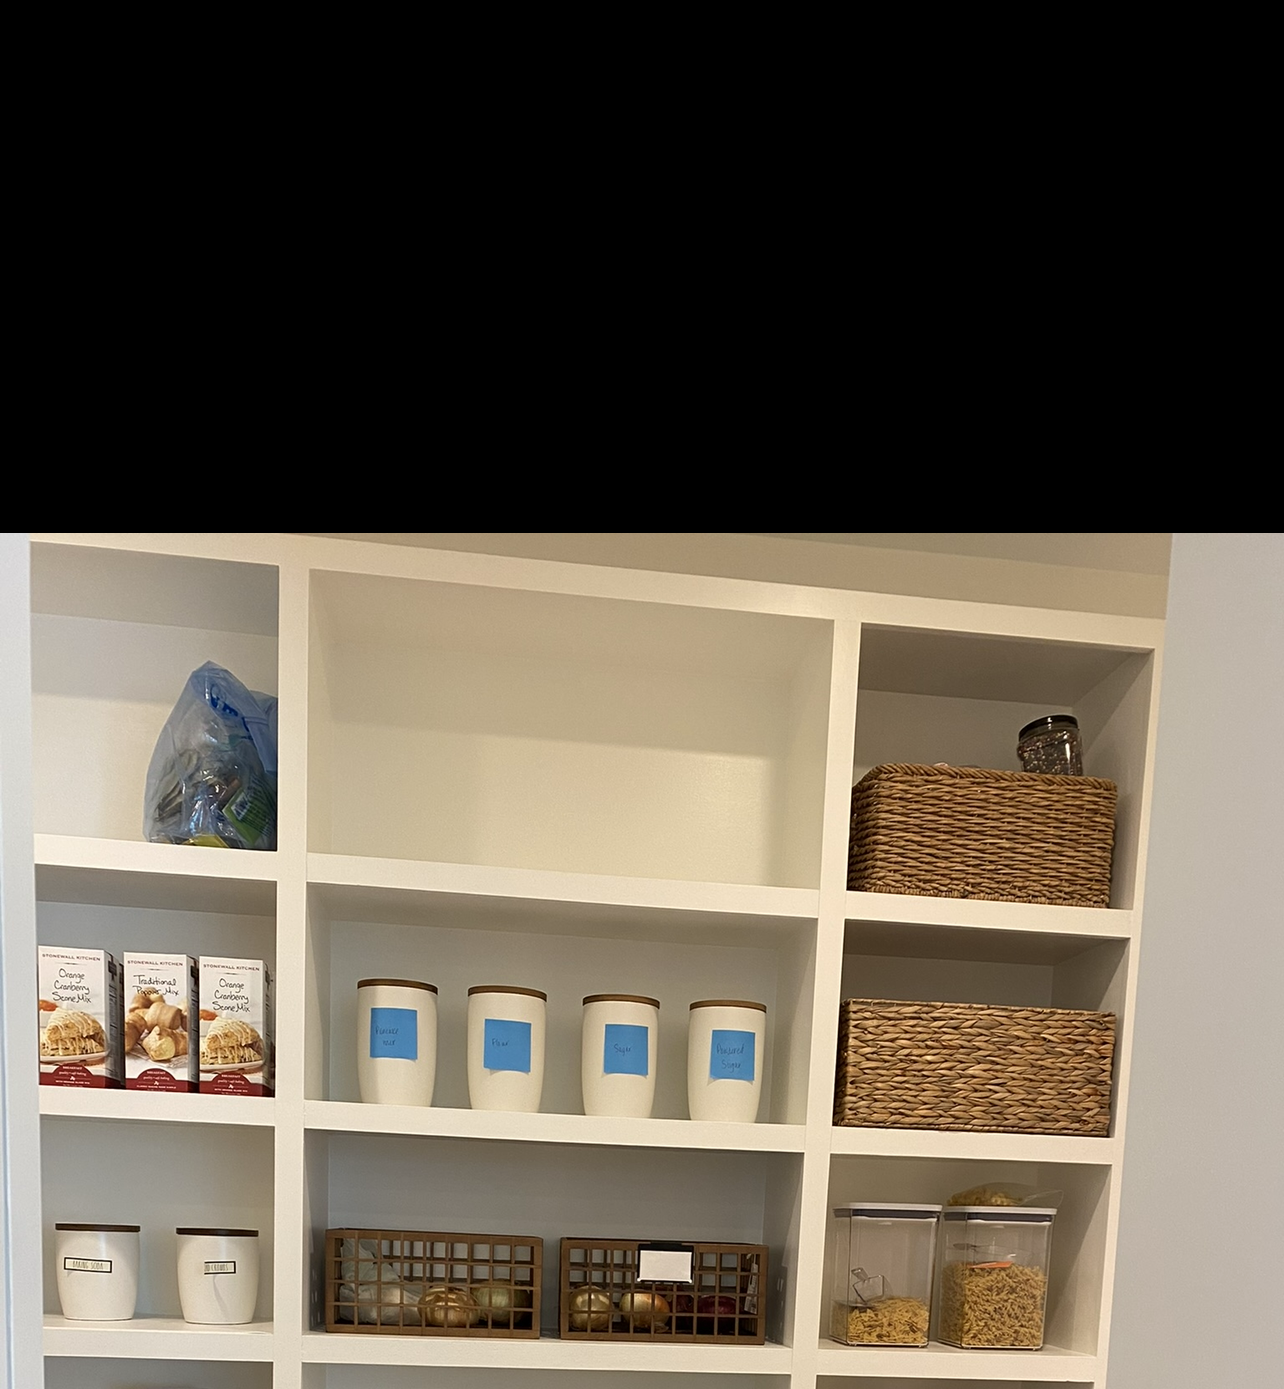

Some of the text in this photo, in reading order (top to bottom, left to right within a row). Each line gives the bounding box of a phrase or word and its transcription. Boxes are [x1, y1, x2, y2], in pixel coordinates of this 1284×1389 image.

[58, 967, 85, 984] Orange
[133, 974, 177, 986] Traditional
[54, 980, 91, 995] Cranberry
[162, 986, 179, 997] Mix
[218, 977, 245, 993] Orange
[51, 991, 92, 1003] Scone Mix
[214, 989, 249, 1005] Cranberry
[212, 1000, 251, 1013] Scone Mix
[613, 1043, 632, 1057] Sugar
[721, 1059, 742, 1073] Sugar
